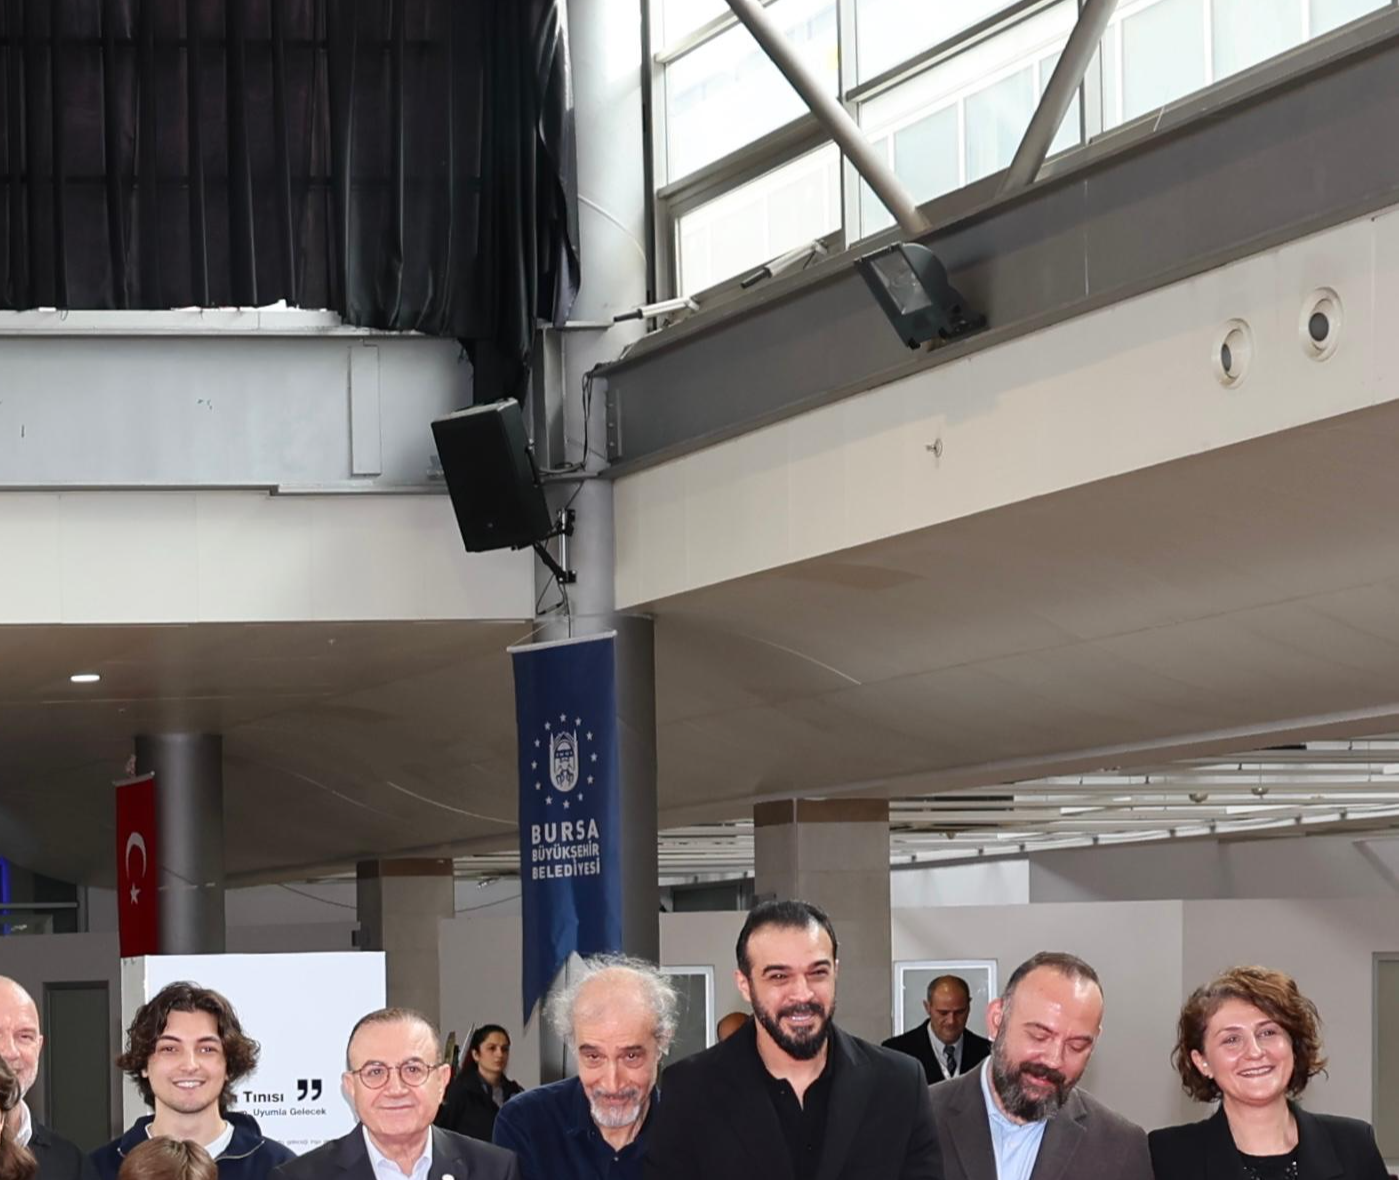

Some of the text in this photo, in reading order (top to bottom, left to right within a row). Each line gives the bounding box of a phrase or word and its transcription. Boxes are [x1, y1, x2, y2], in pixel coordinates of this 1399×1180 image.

[531, 818, 599, 845] BURSA
[531, 840, 600, 863] BÜYÜKŞEHİR
[531, 857, 601, 881] BELEDİYESİ
[243, 1091, 284, 1103] Tınısı
[253, 1108, 287, 1118] Uyumla
[289, 1107, 327, 1116] Gelecek
